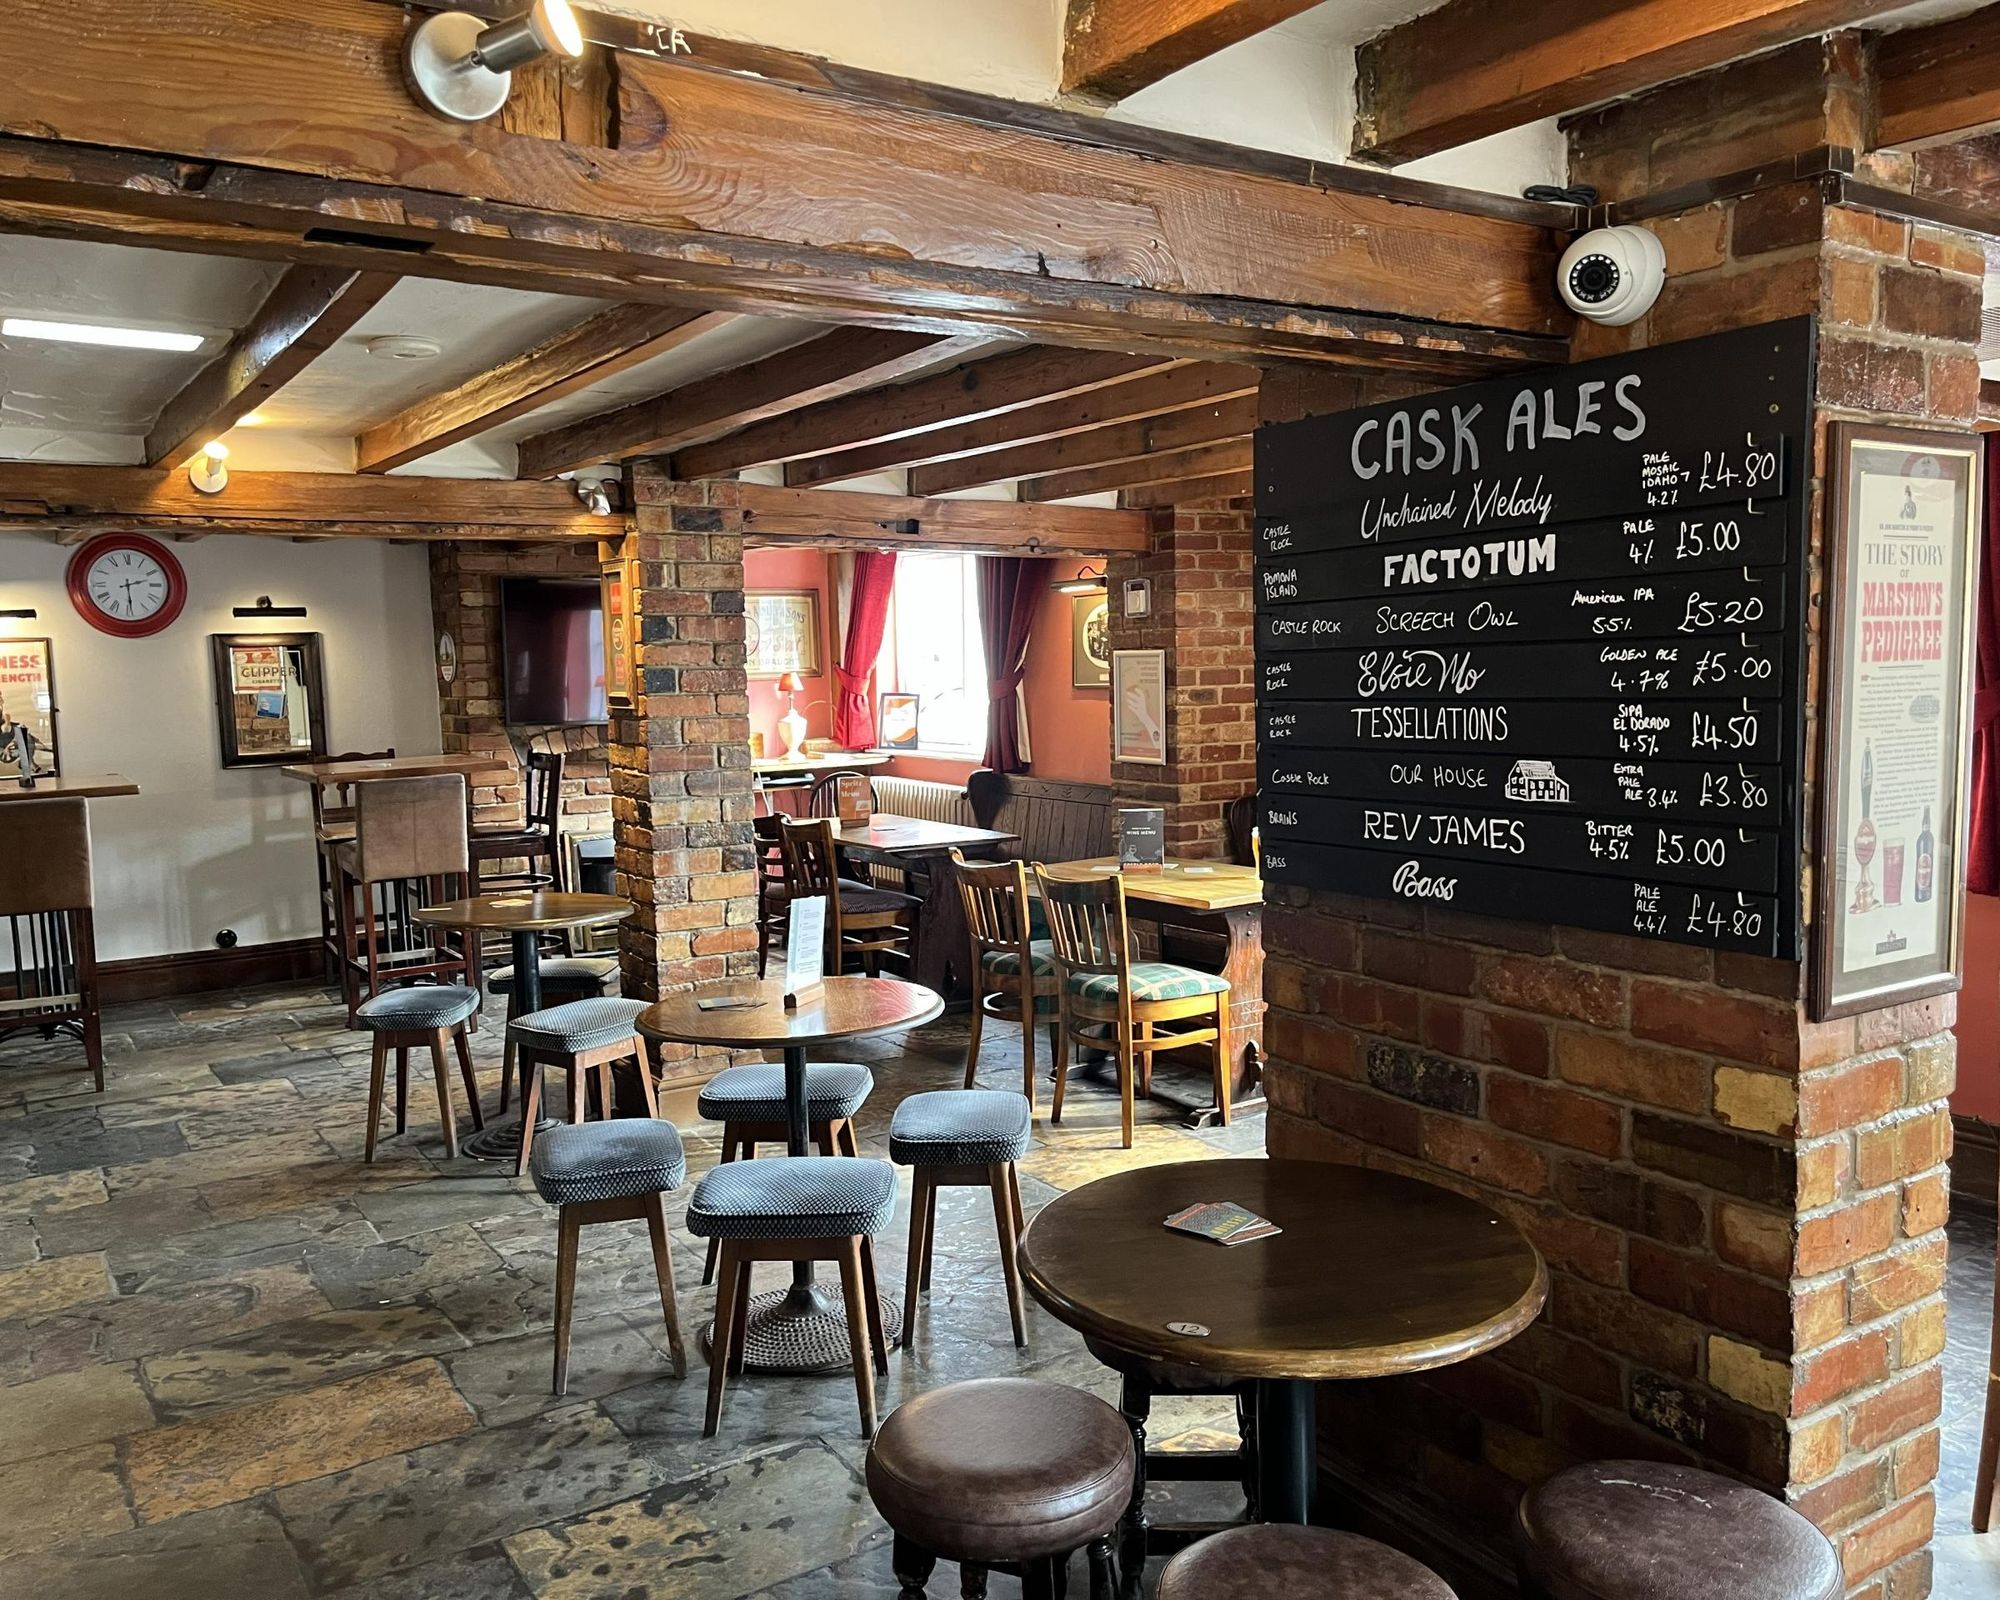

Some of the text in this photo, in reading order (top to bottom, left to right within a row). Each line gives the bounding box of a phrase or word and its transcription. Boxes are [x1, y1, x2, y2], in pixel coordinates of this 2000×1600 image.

[1351, 374, 1646, 480] CASK ALES
[1642, 451, 1671, 466] PALE
[1642, 461, 1680, 477] MOSAIC
[1699, 451, 1776, 493] £4.80
[1642, 474, 1678, 489] IDAHO
[1647, 489, 1678, 507] 4.2%
[1361, 474, 1553, 542] Unchained Melody
[1263, 524, 1292, 540] CASTLE
[1623, 519, 1656, 535] PALE
[1270, 538, 1293, 552] ROCK
[1676, 520, 1741, 560] £5.00
[1384, 533, 1556, 588] FACTOTUM
[1629, 538, 1654, 564] 4%
[1864, 543, 1946, 566] THE STORY
[1263, 569, 1298, 586] POMONA
[1900, 569, 1910, 578] OF
[1266, 584, 1298, 601] ISLAND
[1571, 587, 1655, 606] American IPA
[1862, 581, 1943, 617] MARSTON'S
[1677, 591, 1764, 633] £5.20
[1272, 619, 1342, 636] CASTLE ROCK
[1861, 619, 1943, 663] PEDIGREE
[1600, 646, 1647, 663] GOLDEN
[241, 665, 298, 678] CLIPPER
[1266, 662, 1292, 676] CASTLE
[1358, 649, 1487, 698] Elsie Mo
[1693, 650, 1772, 687] £5.00
[1266, 678, 1289, 692] ROCK
[1611, 669, 1671, 693] 4.7%
[1269, 714, 1297, 726] CASTLE
[1351, 705, 1509, 742] TESSELLATIONS
[1613, 716, 1670, 731] EL DORADO
[1269, 728, 1292, 739] ROCK
[1692, 711, 1758, 750] £4.50
[1619, 734, 1659, 757] 4.5%
[1390, 763, 1489, 788] OUR HOUSE
[1617, 776, 1641, 788] PALE
[1624, 787, 1679, 809] ALE 3.4%
[1700, 771, 1768, 808] £3.80
[1268, 810, 1298, 825] BRAINS
[1363, 810, 1526, 854] REV JAMES
[1585, 820, 1635, 837] BITTER
[1589, 838, 1630, 860] 4.5%
[1656, 828, 1726, 867] £5.00
[1265, 854, 1287, 868] BASS
[1392, 860, 1459, 901] Bass
[1634, 883, 1661, 899] PALE
[1636, 899, 1658, 912] ALE
[1633, 914, 1667, 935] 4.4%
[1686, 893, 1762, 938] £4.80
[1179, 1323, 1200, 1335] 12
